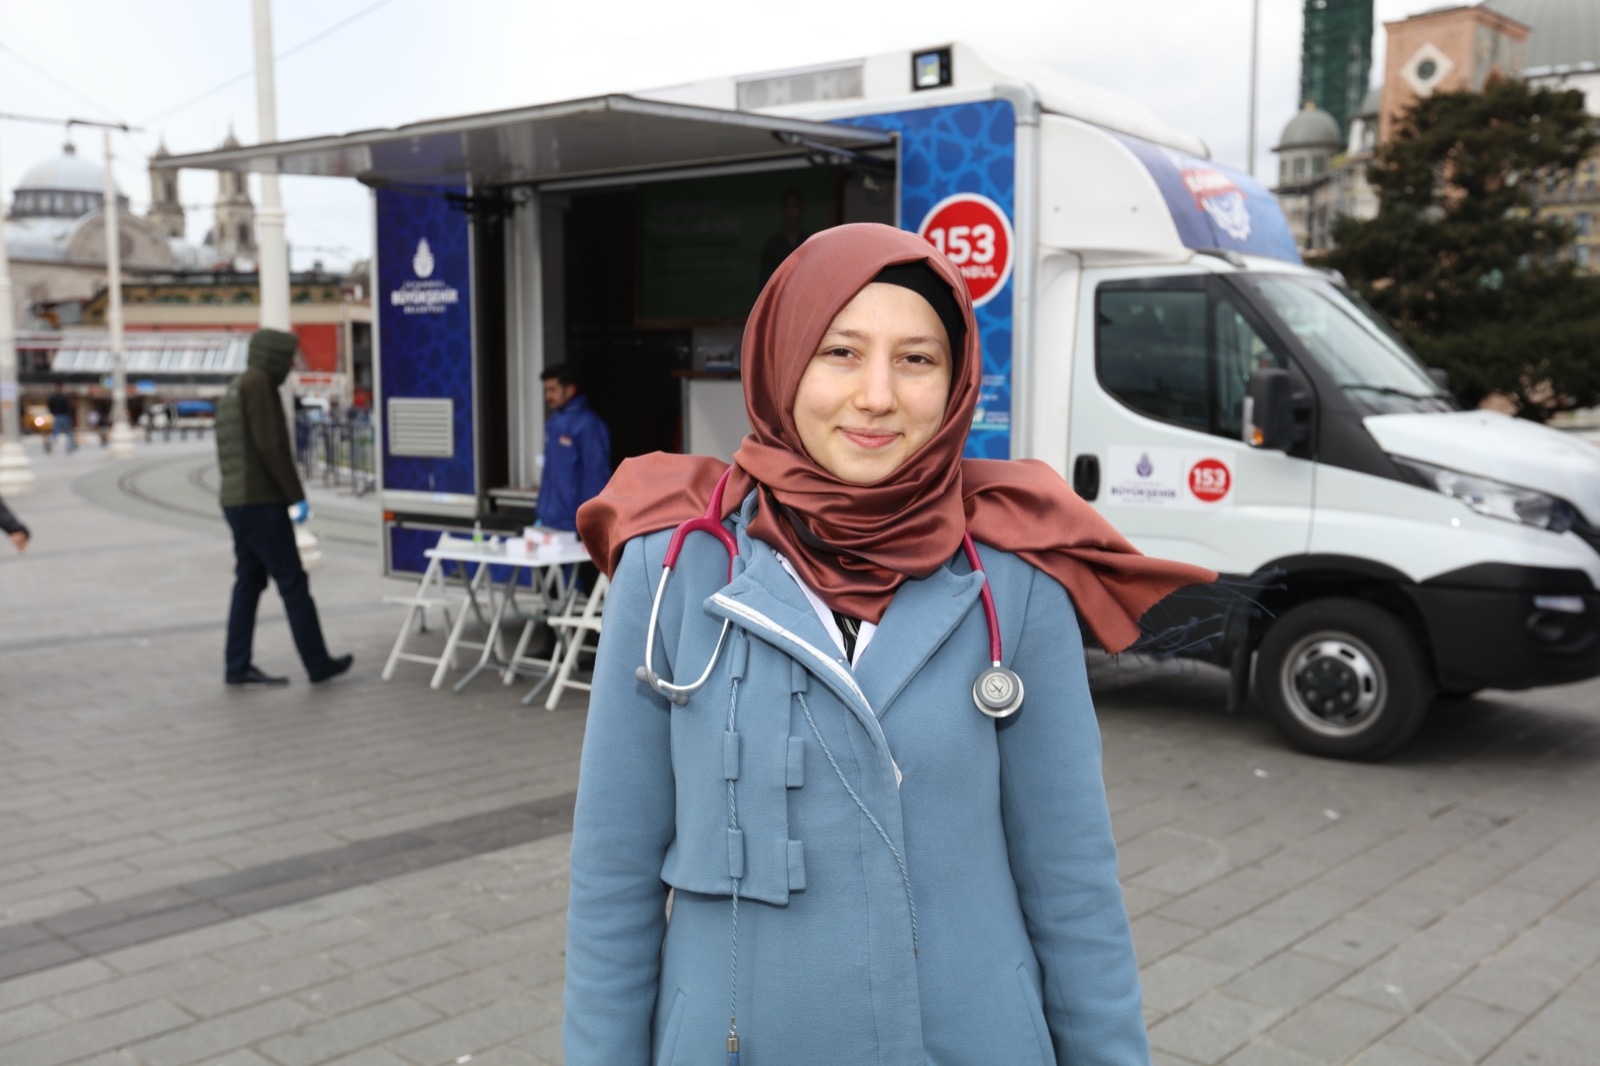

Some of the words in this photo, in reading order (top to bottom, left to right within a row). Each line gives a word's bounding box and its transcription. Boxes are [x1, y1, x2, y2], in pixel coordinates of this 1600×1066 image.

[929, 223, 996, 265] 153
[960, 265, 997, 279] NBUL
[1193, 466, 1227, 488] 153
